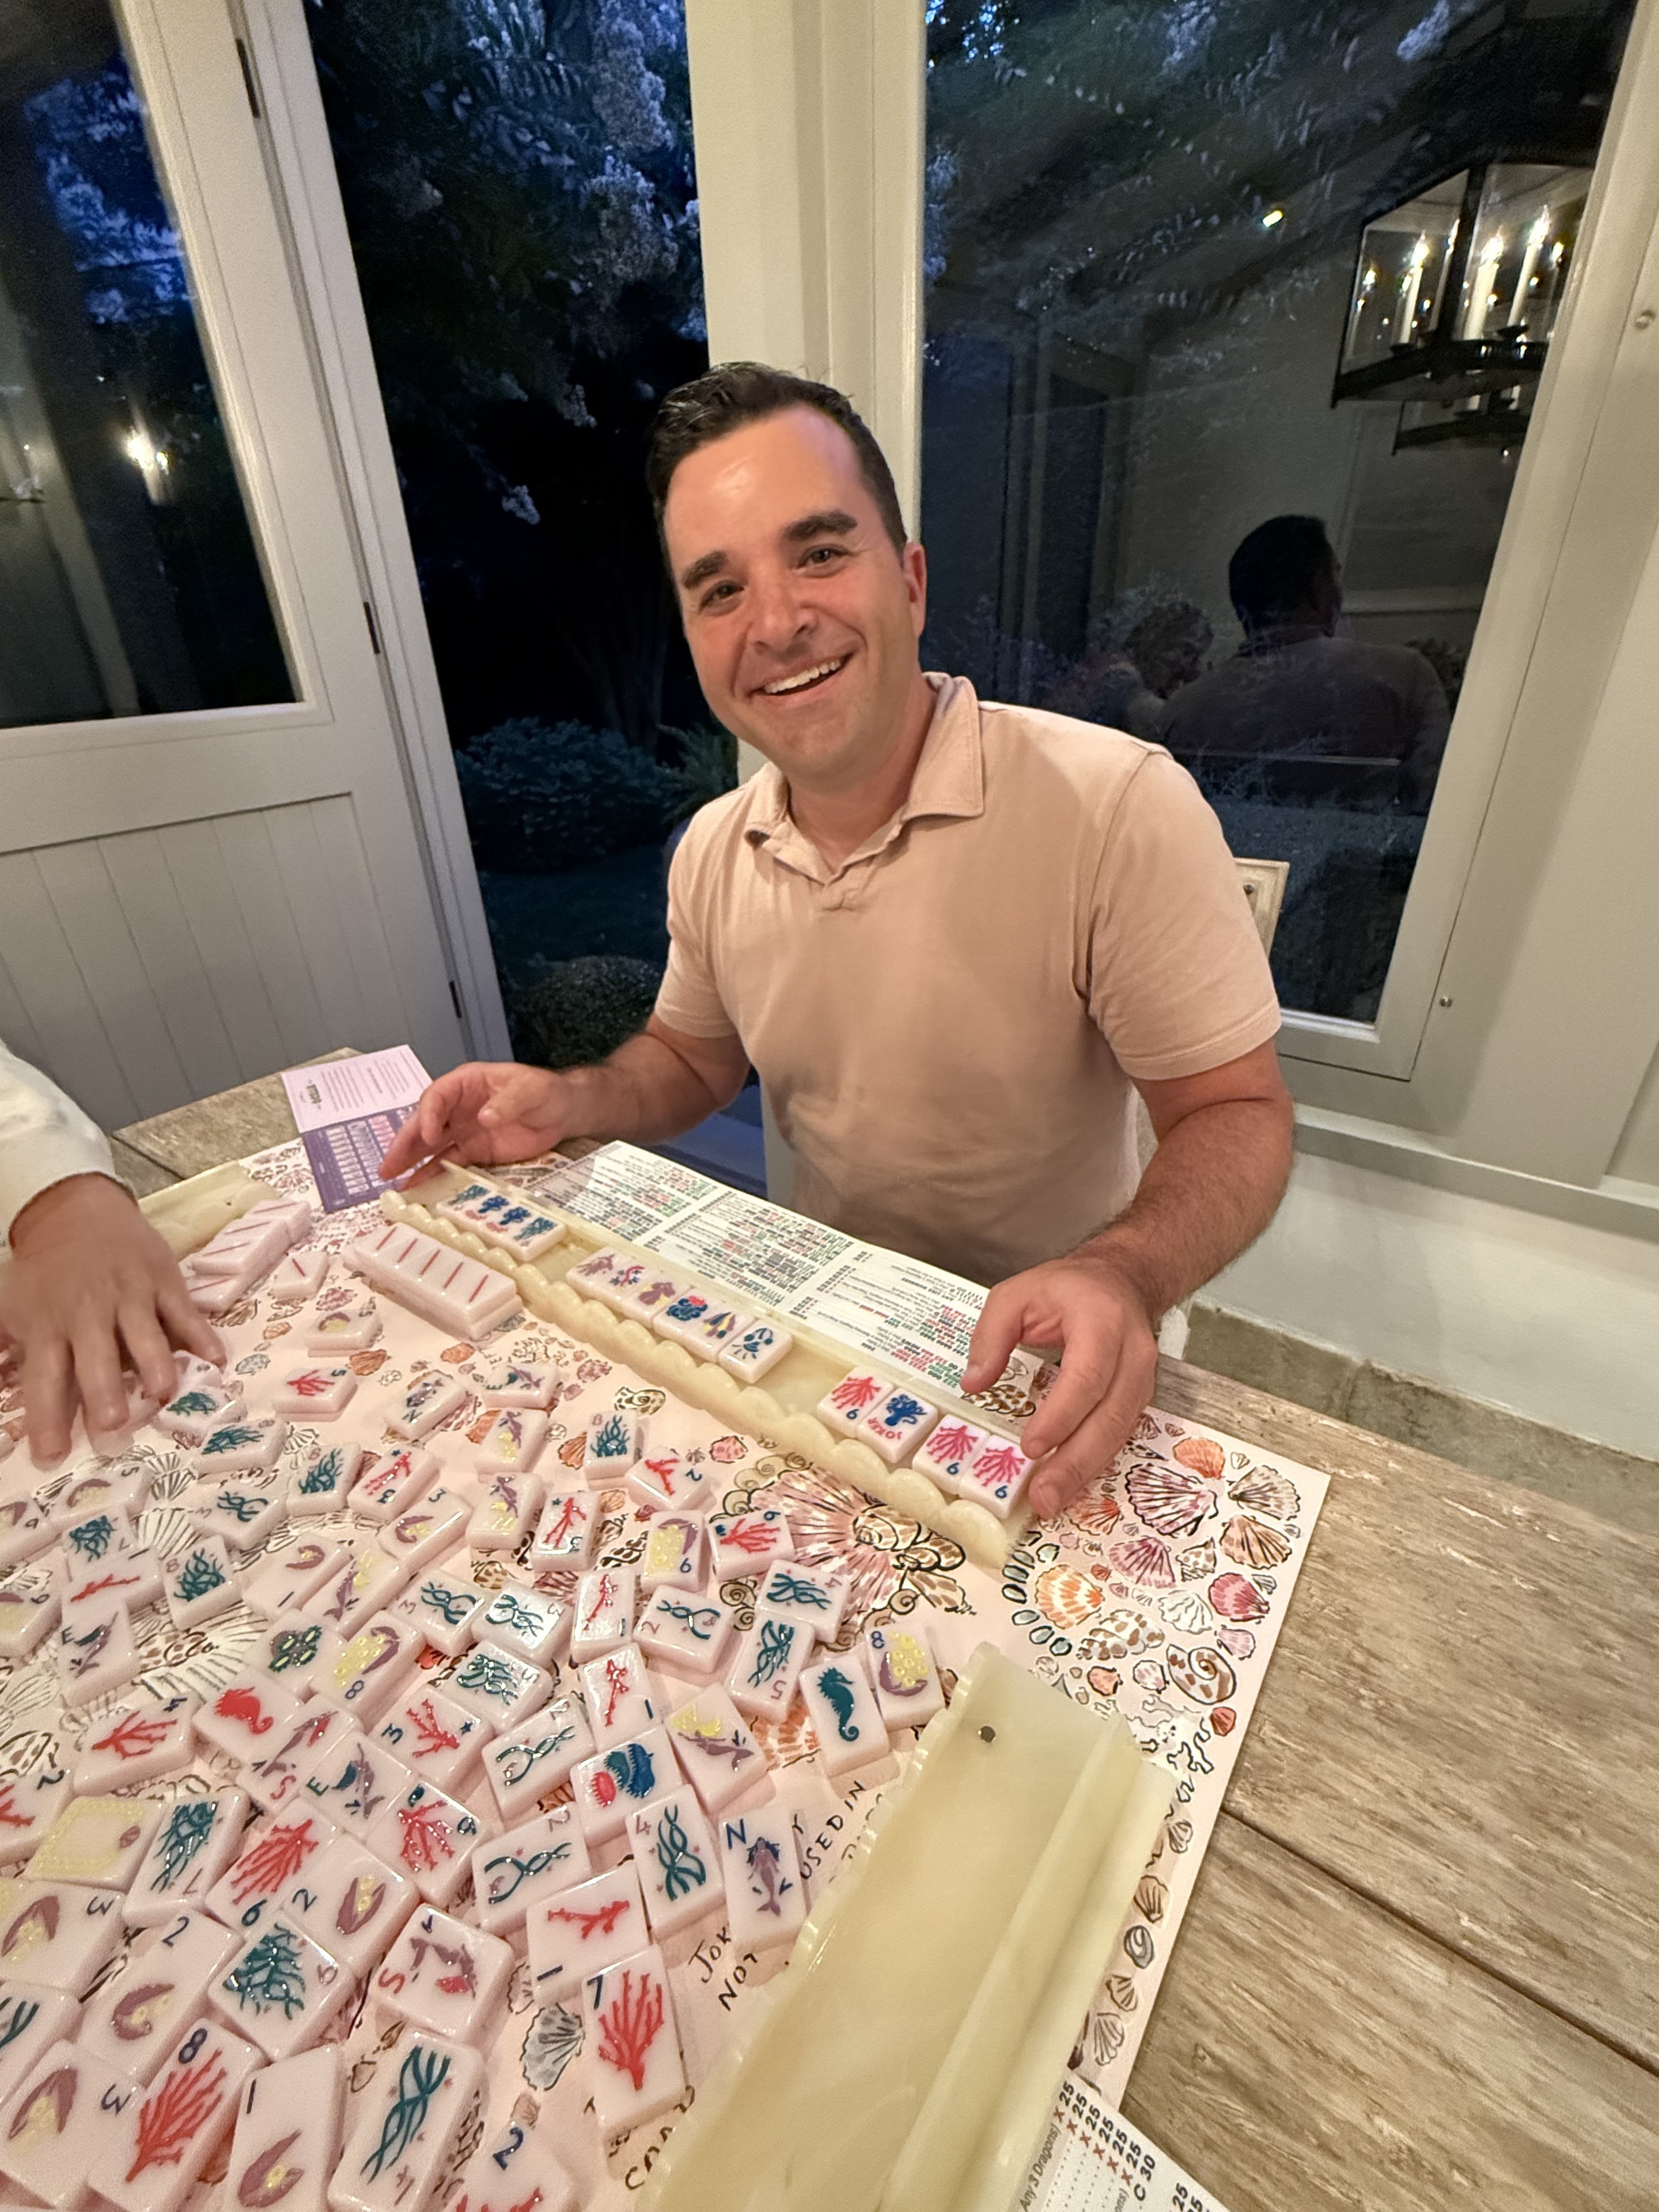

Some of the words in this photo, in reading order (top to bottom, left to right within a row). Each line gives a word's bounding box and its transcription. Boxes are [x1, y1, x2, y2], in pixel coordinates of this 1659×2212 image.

[867, 1417, 902, 1440] JOKER
[871, 1631, 885, 1649] 8
[346, 1680, 364, 1699] 8
[306, 1777, 329, 1796] E
[726, 1819, 747, 1849] N
[800, 1815, 843, 1879] USED
[844, 1780, 866, 1811] IN
[292, 1889, 317, 1911] 2
[162, 1916, 189, 1946] 2
[179, 2028, 207, 2064] 8
[1073, 2093, 1087, 2118] 25
[1086, 2105, 1100, 2130] 25
[1033, 2123, 1062, 2176] Dragons)
[1059, 2081, 1074, 2106] 25
[1099, 2117, 1113, 2143] 25
[1112, 2128, 1127, 2155] 25
[493, 2126, 524, 2171] 2
[1126, 2141, 1141, 2168] 25
[1134, 2184, 1146, 2201] C
[1141, 2155, 1156, 2181] 30
[1172, 2183, 1188, 2212] 25
